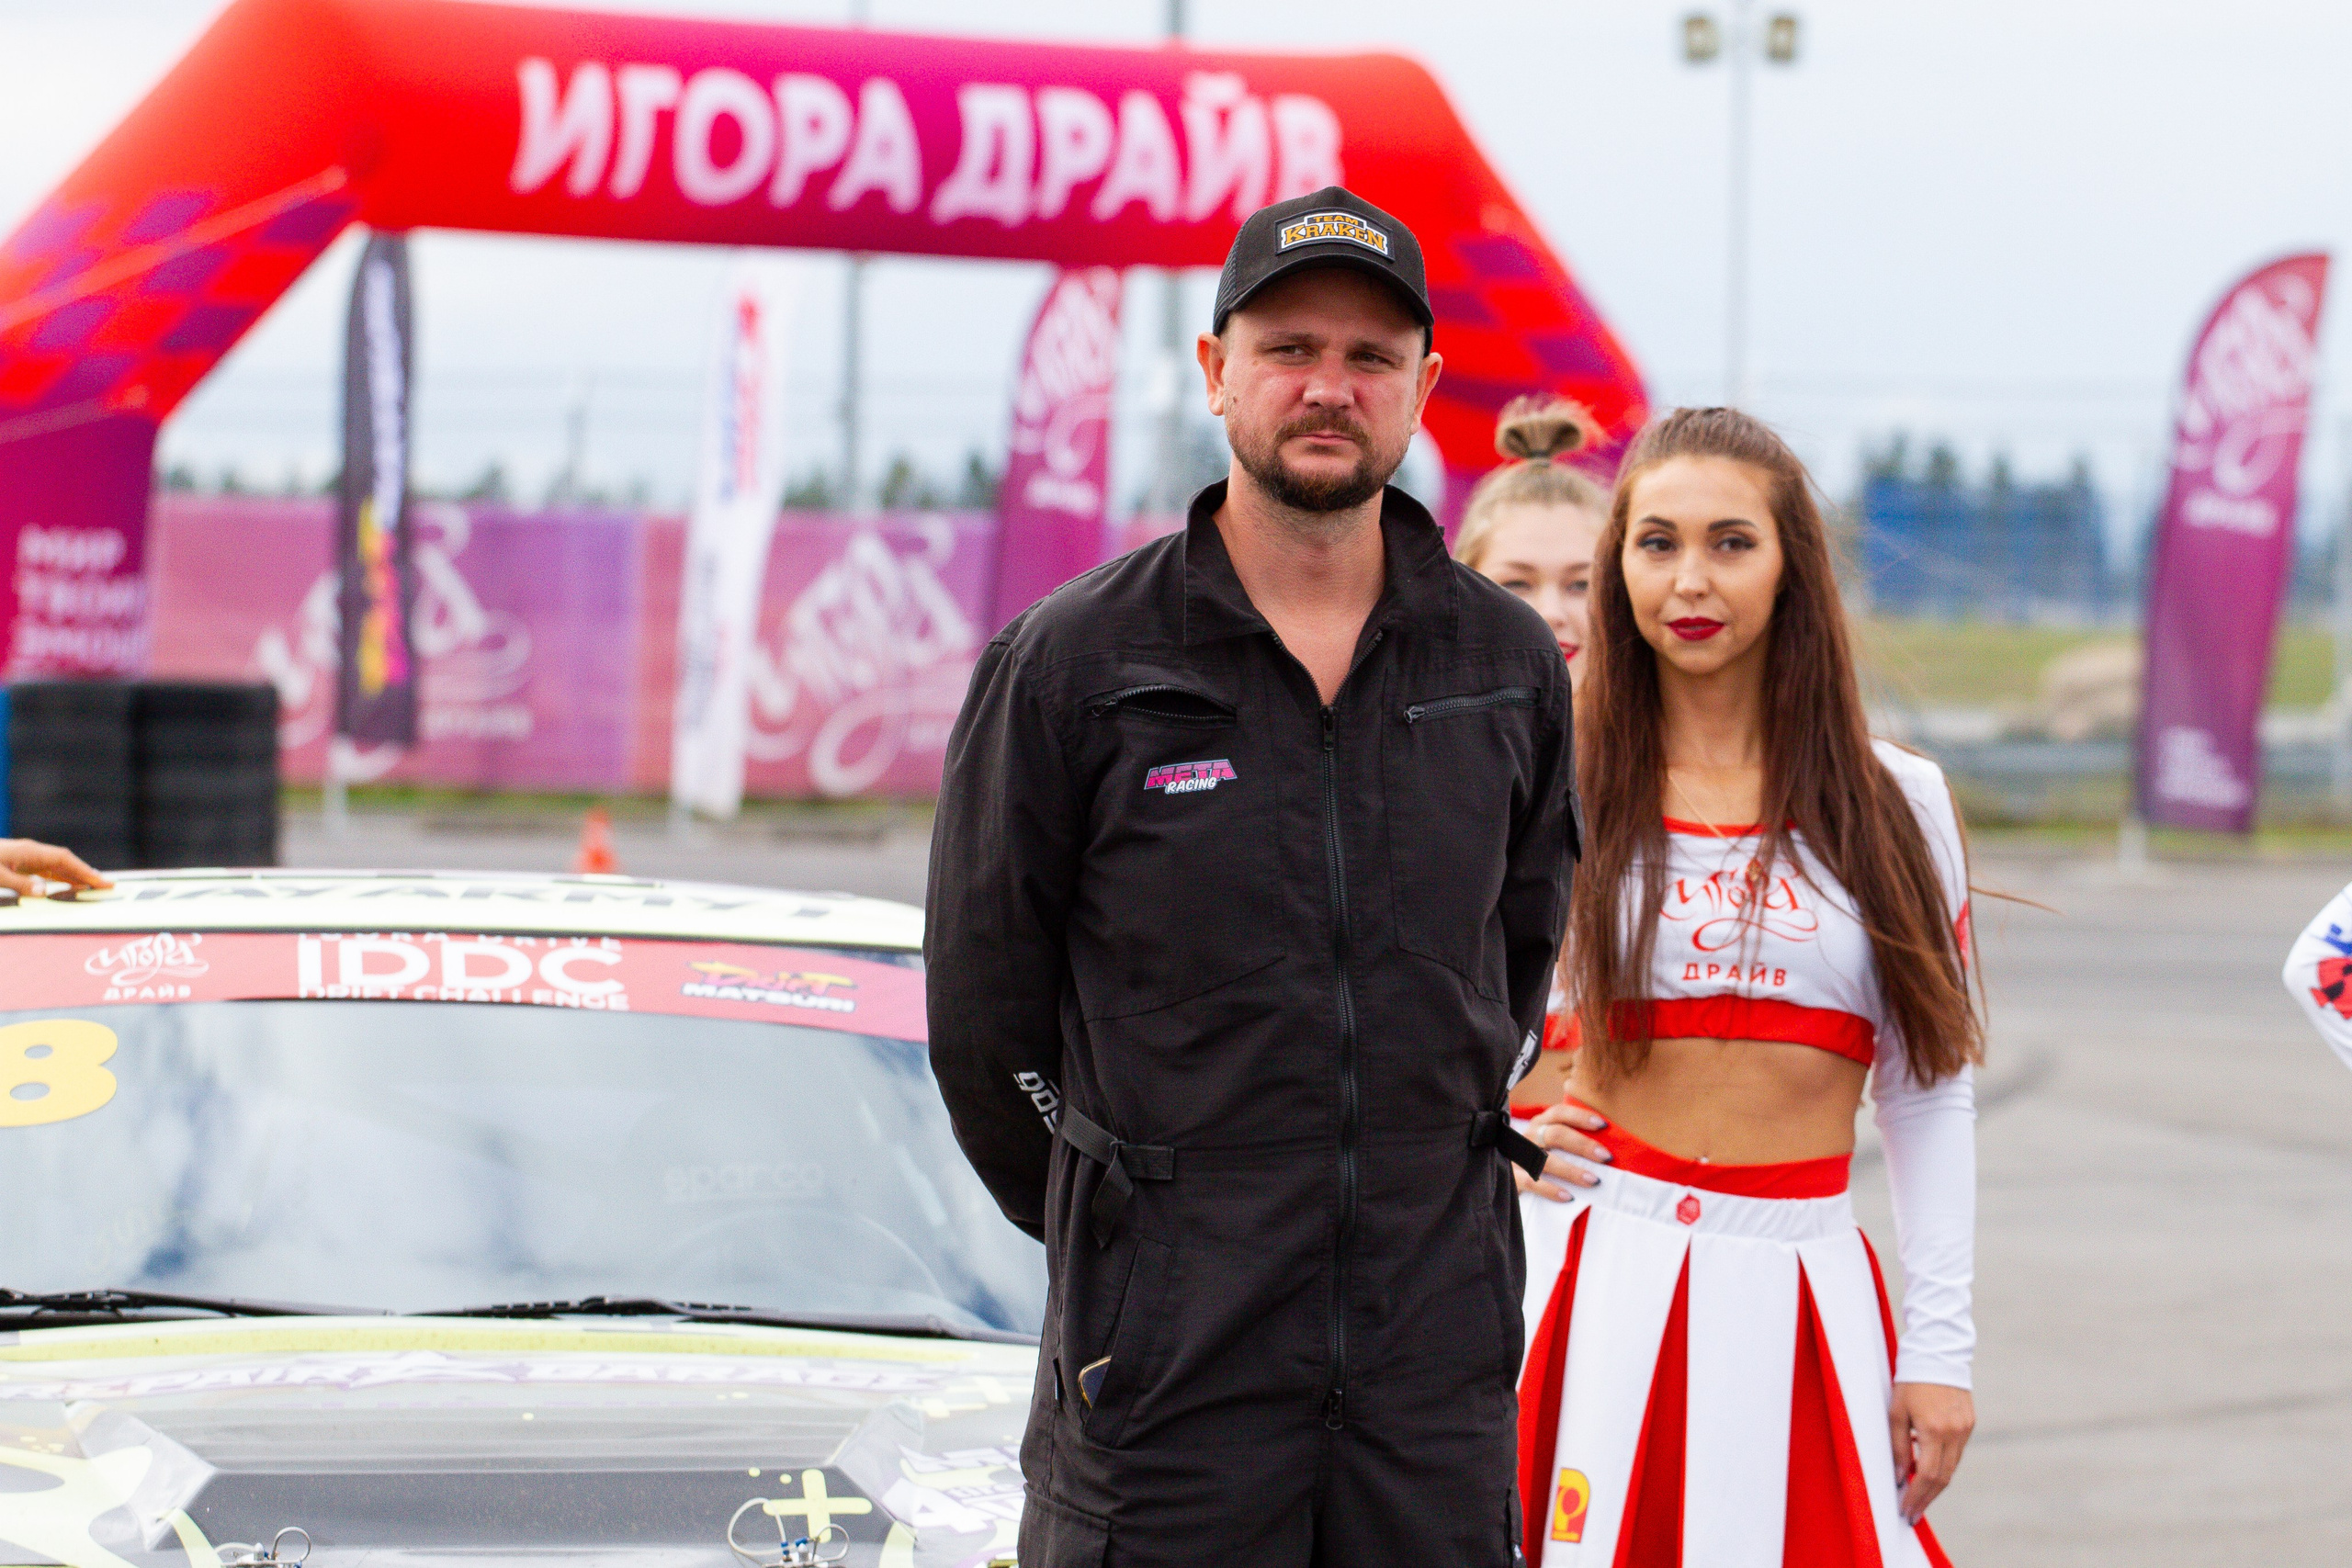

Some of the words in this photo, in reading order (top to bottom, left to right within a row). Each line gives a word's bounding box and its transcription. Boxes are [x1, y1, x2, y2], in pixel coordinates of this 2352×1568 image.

[511, 57, 921, 214] ИГОРА
[930, 73, 1344, 228] ДРАЙВ
[1313, 215, 1359, 226] TEAM
[1284, 223, 1385, 251] KRAKEN
[1144, 760, 1237, 789] META
[1165, 777, 1217, 794] RACING
[298, 939, 625, 995] IDDC
[1682, 962, 1787, 987] ДРАЙВ
[103, 984, 191, 1000] ДРАЙВ
[682, 983, 854, 1012] MATSURI
